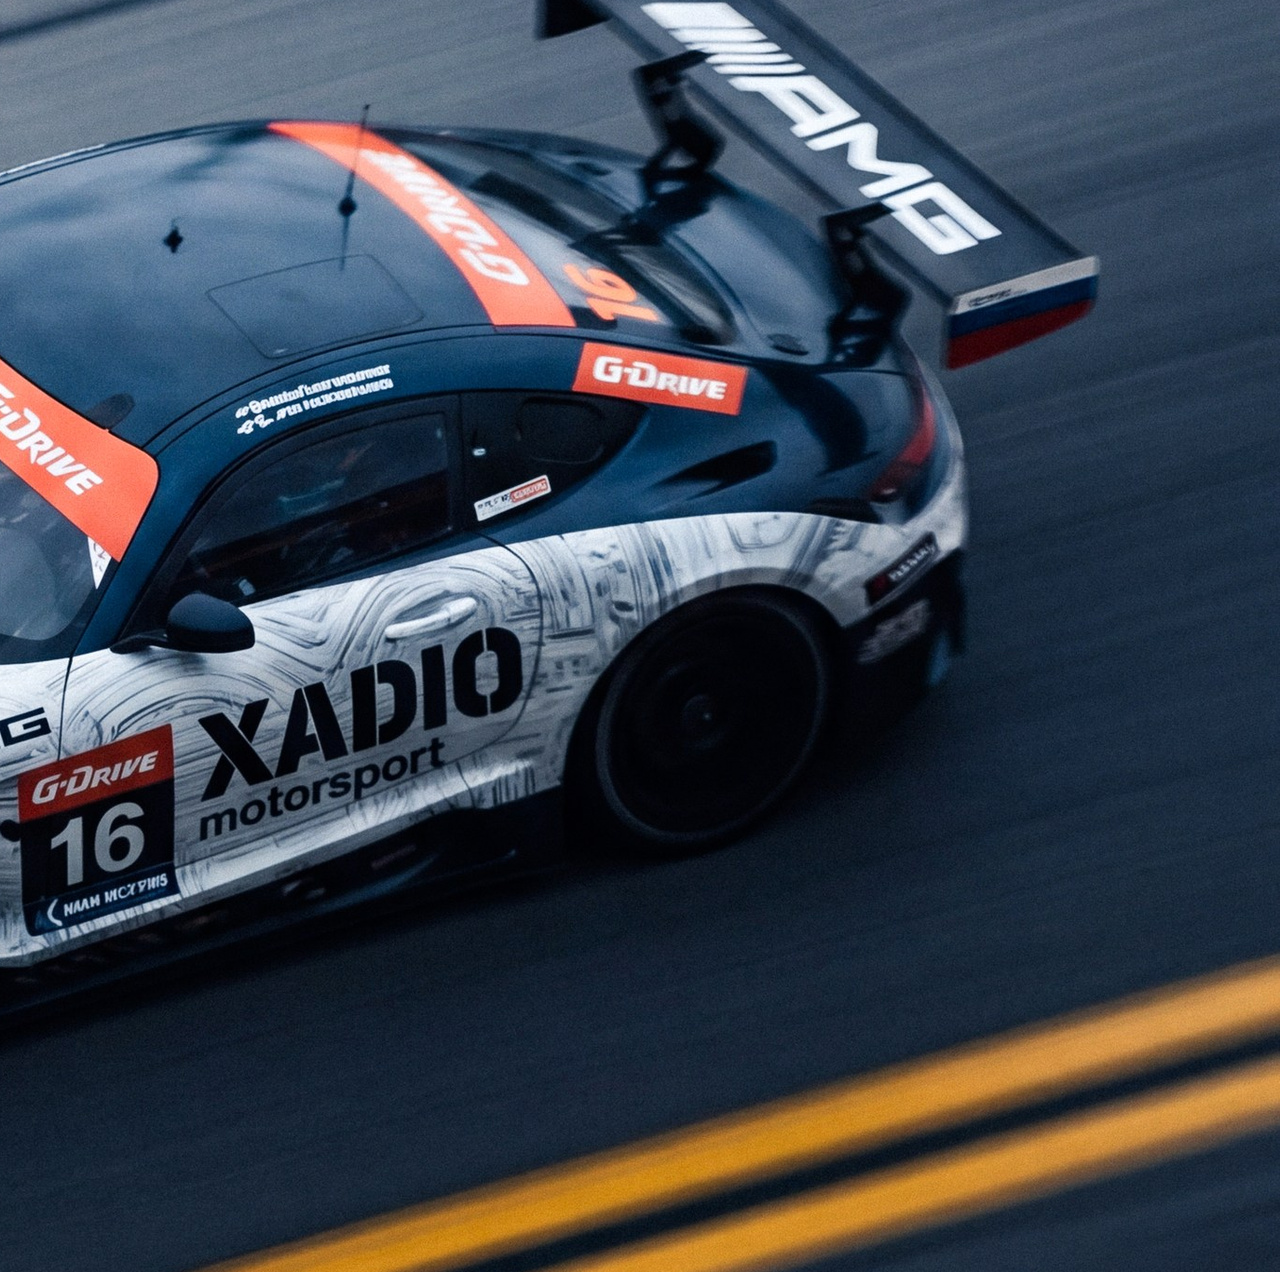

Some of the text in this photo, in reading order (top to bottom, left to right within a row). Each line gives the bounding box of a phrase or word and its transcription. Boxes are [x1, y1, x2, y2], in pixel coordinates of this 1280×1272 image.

[727, 75, 1003, 255] AMG
[563, 263, 657, 321] 16
[593, 355, 728, 400] G-DRIVE
[198, 626, 524, 803] XADIO
[32, 750, 159, 805] G-DRIVE
[198, 736, 445, 842] motorsport
[50, 801, 145, 887] 16
